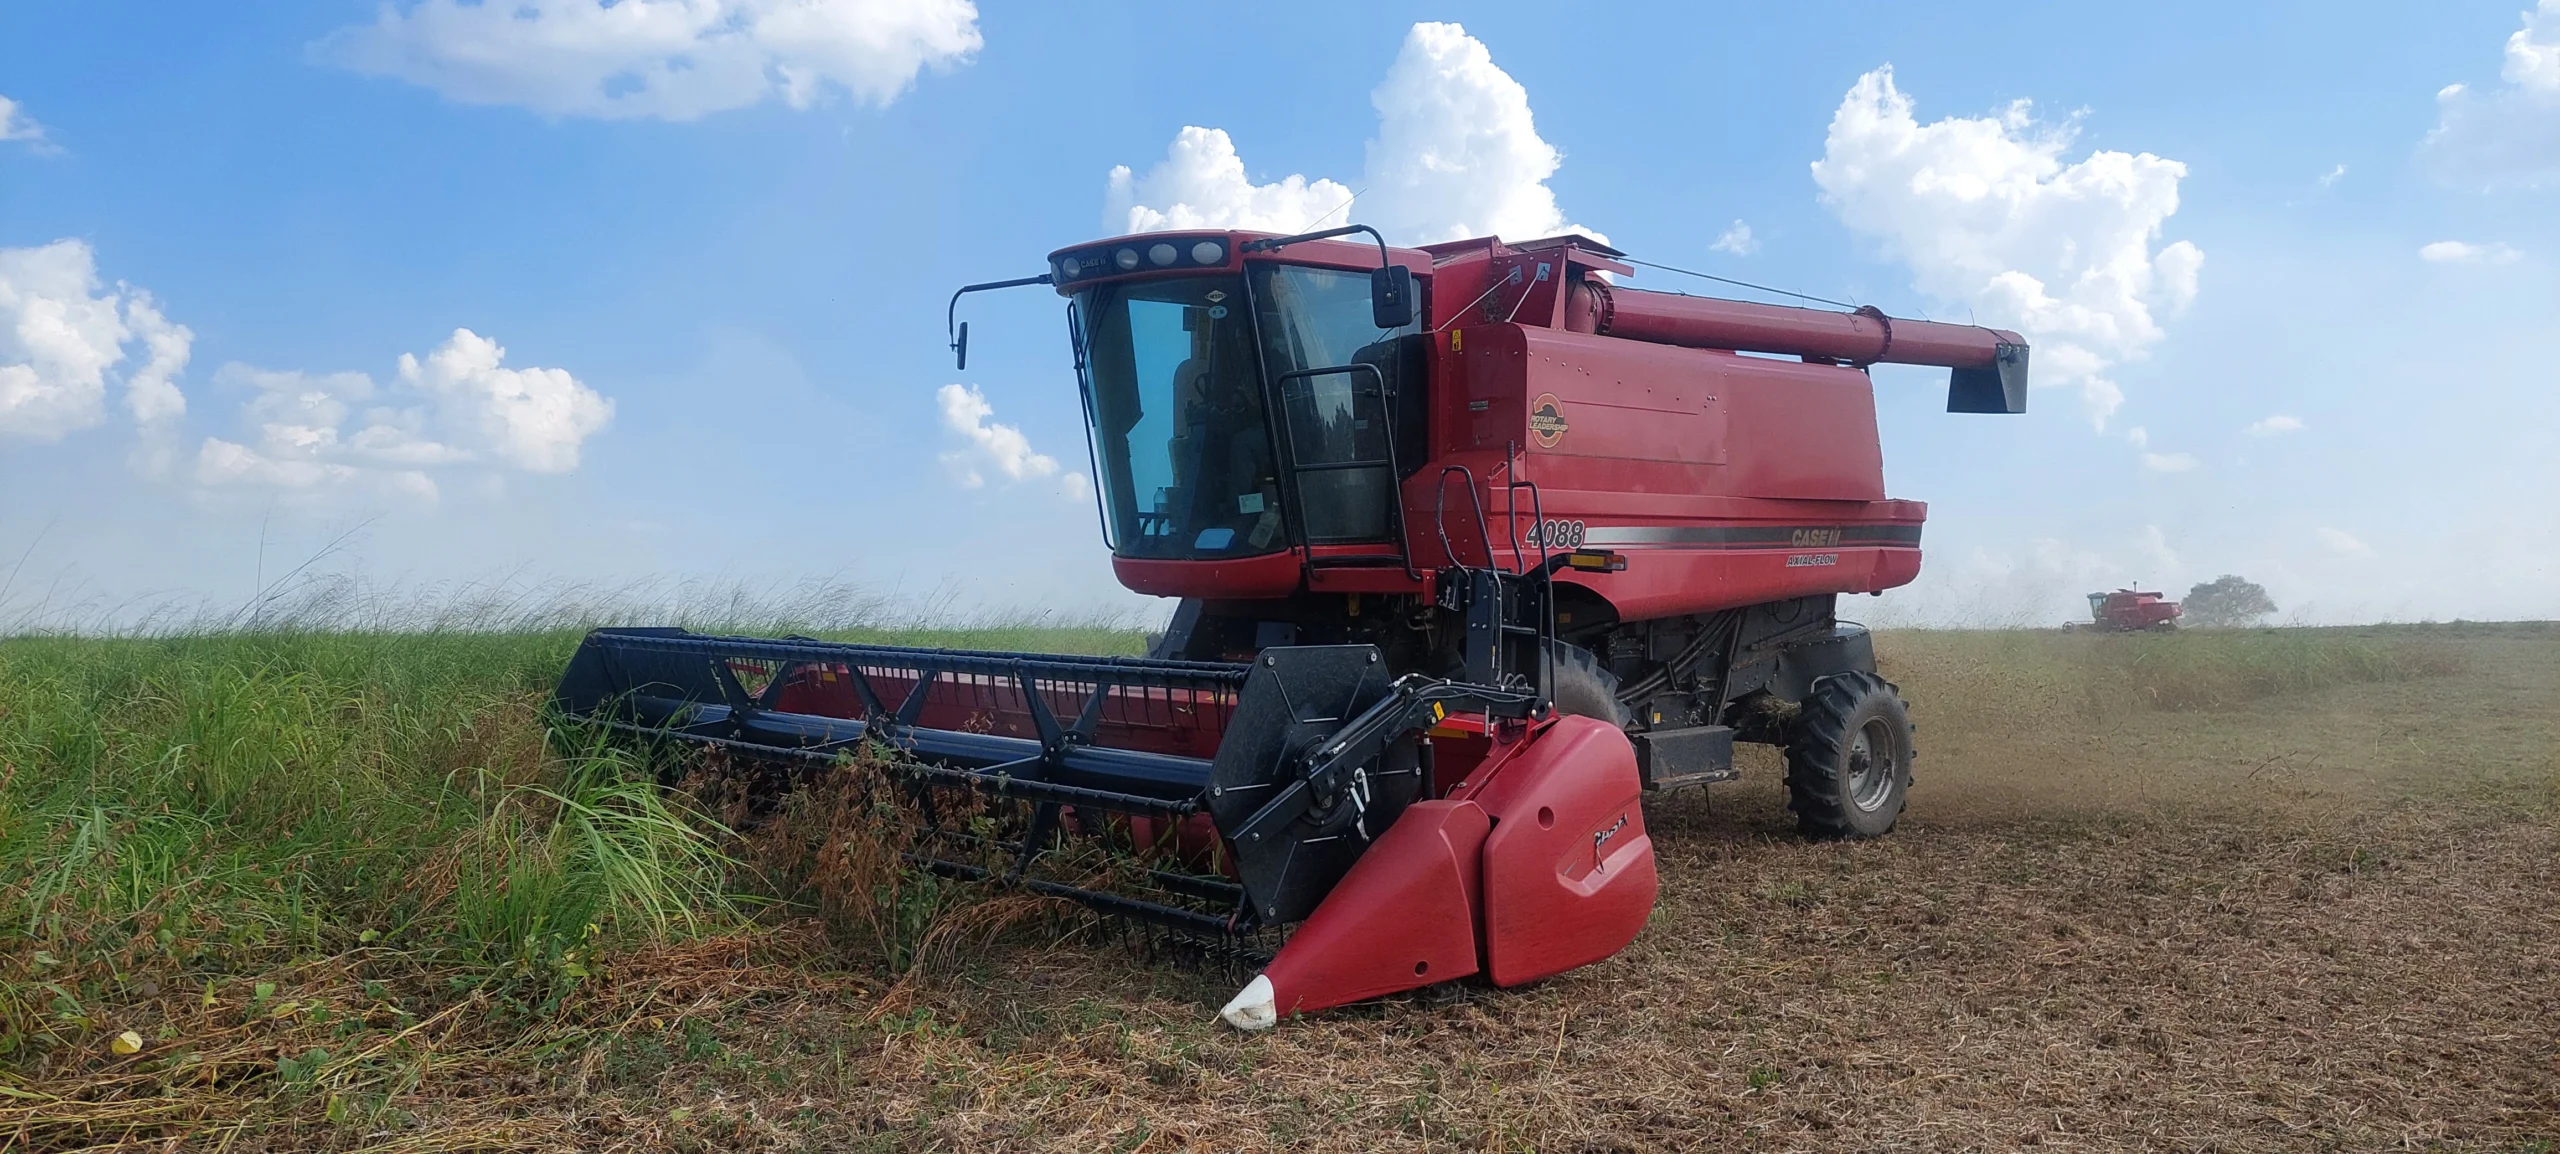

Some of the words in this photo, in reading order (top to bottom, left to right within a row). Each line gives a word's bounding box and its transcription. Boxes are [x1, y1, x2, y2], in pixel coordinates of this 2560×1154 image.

[1080, 258, 1099, 269] CASE
[1530, 415, 1558, 424] ROTARY
[1529, 422, 1569, 431] LEADERSHIP
[1525, 519, 1585, 548] 4088
[1791, 528, 1829, 547] CASE
[1785, 554, 1839, 567] AXIAL-FLOW
